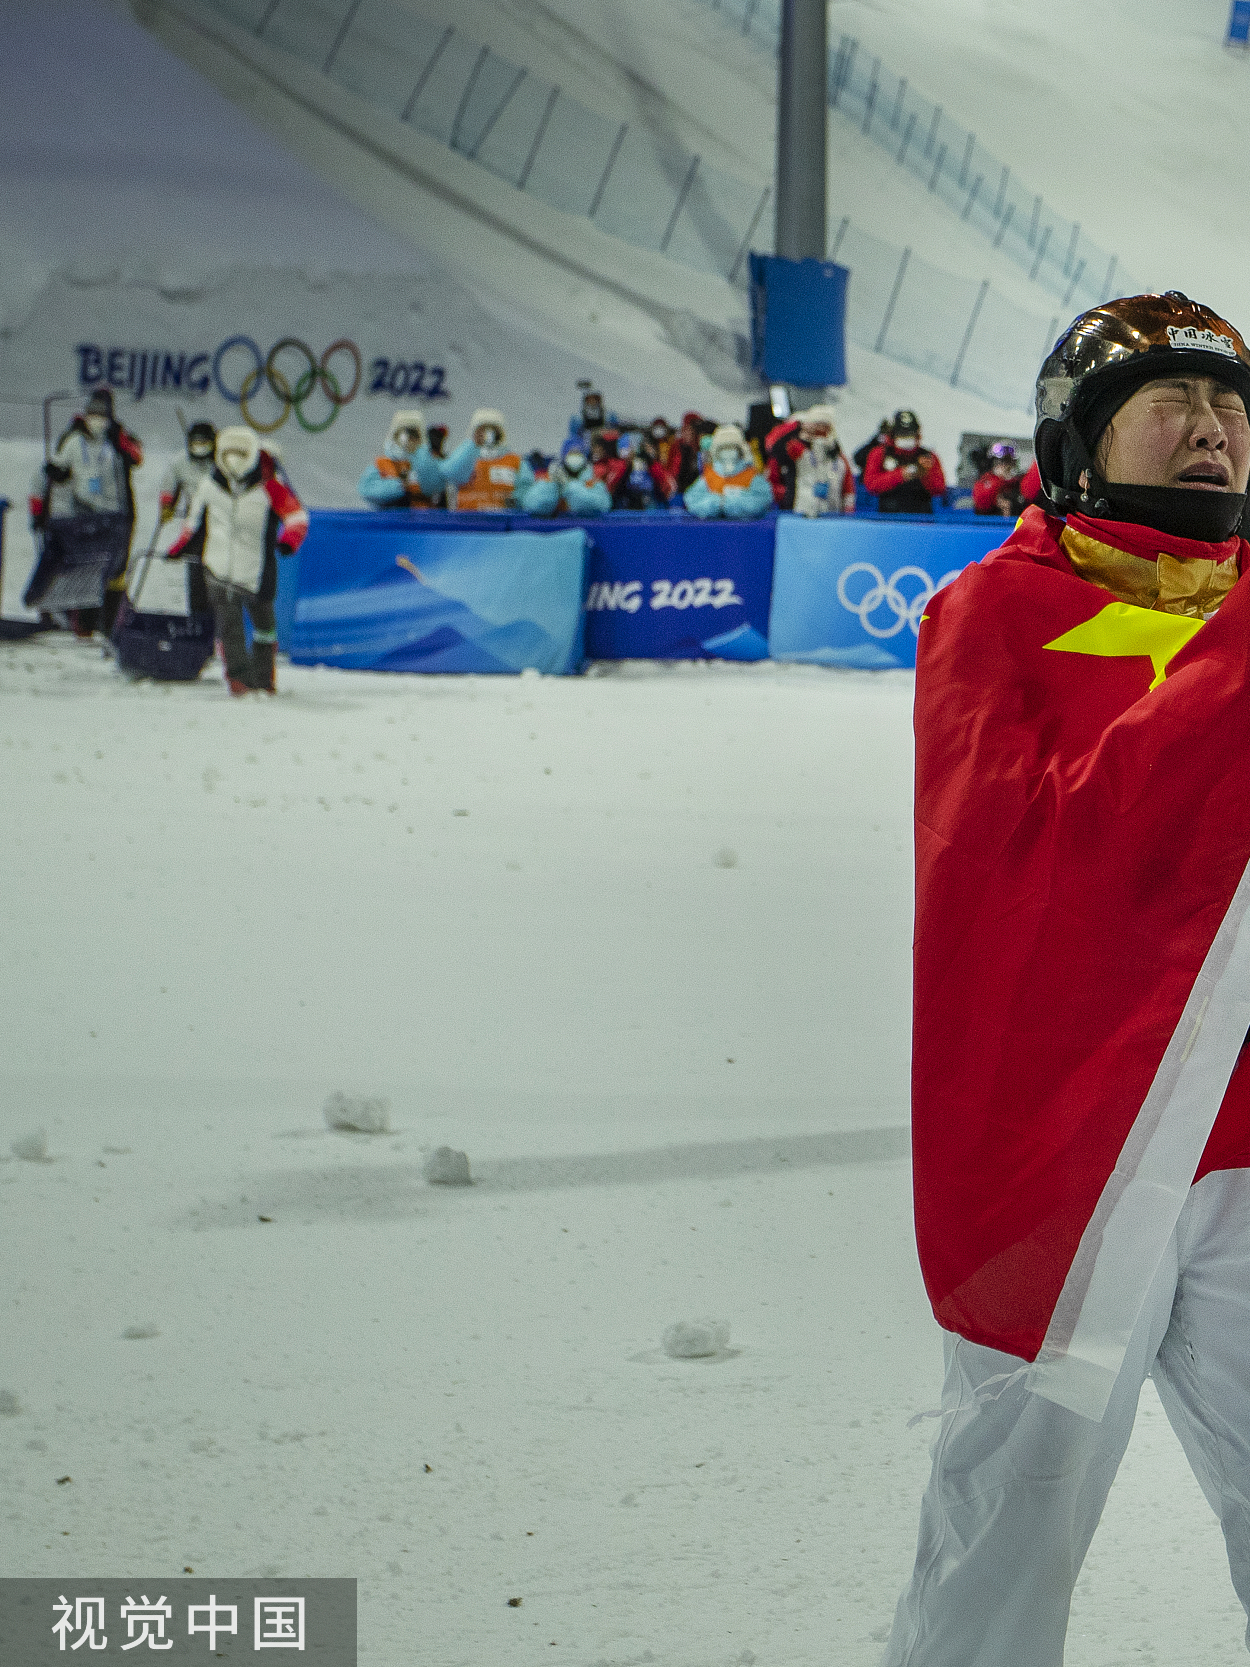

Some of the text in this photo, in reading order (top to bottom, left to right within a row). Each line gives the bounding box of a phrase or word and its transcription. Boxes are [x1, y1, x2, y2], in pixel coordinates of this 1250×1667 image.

[76, 344, 449, 399] BEIJING 2022
[584, 577, 744, 613] ING 2022
